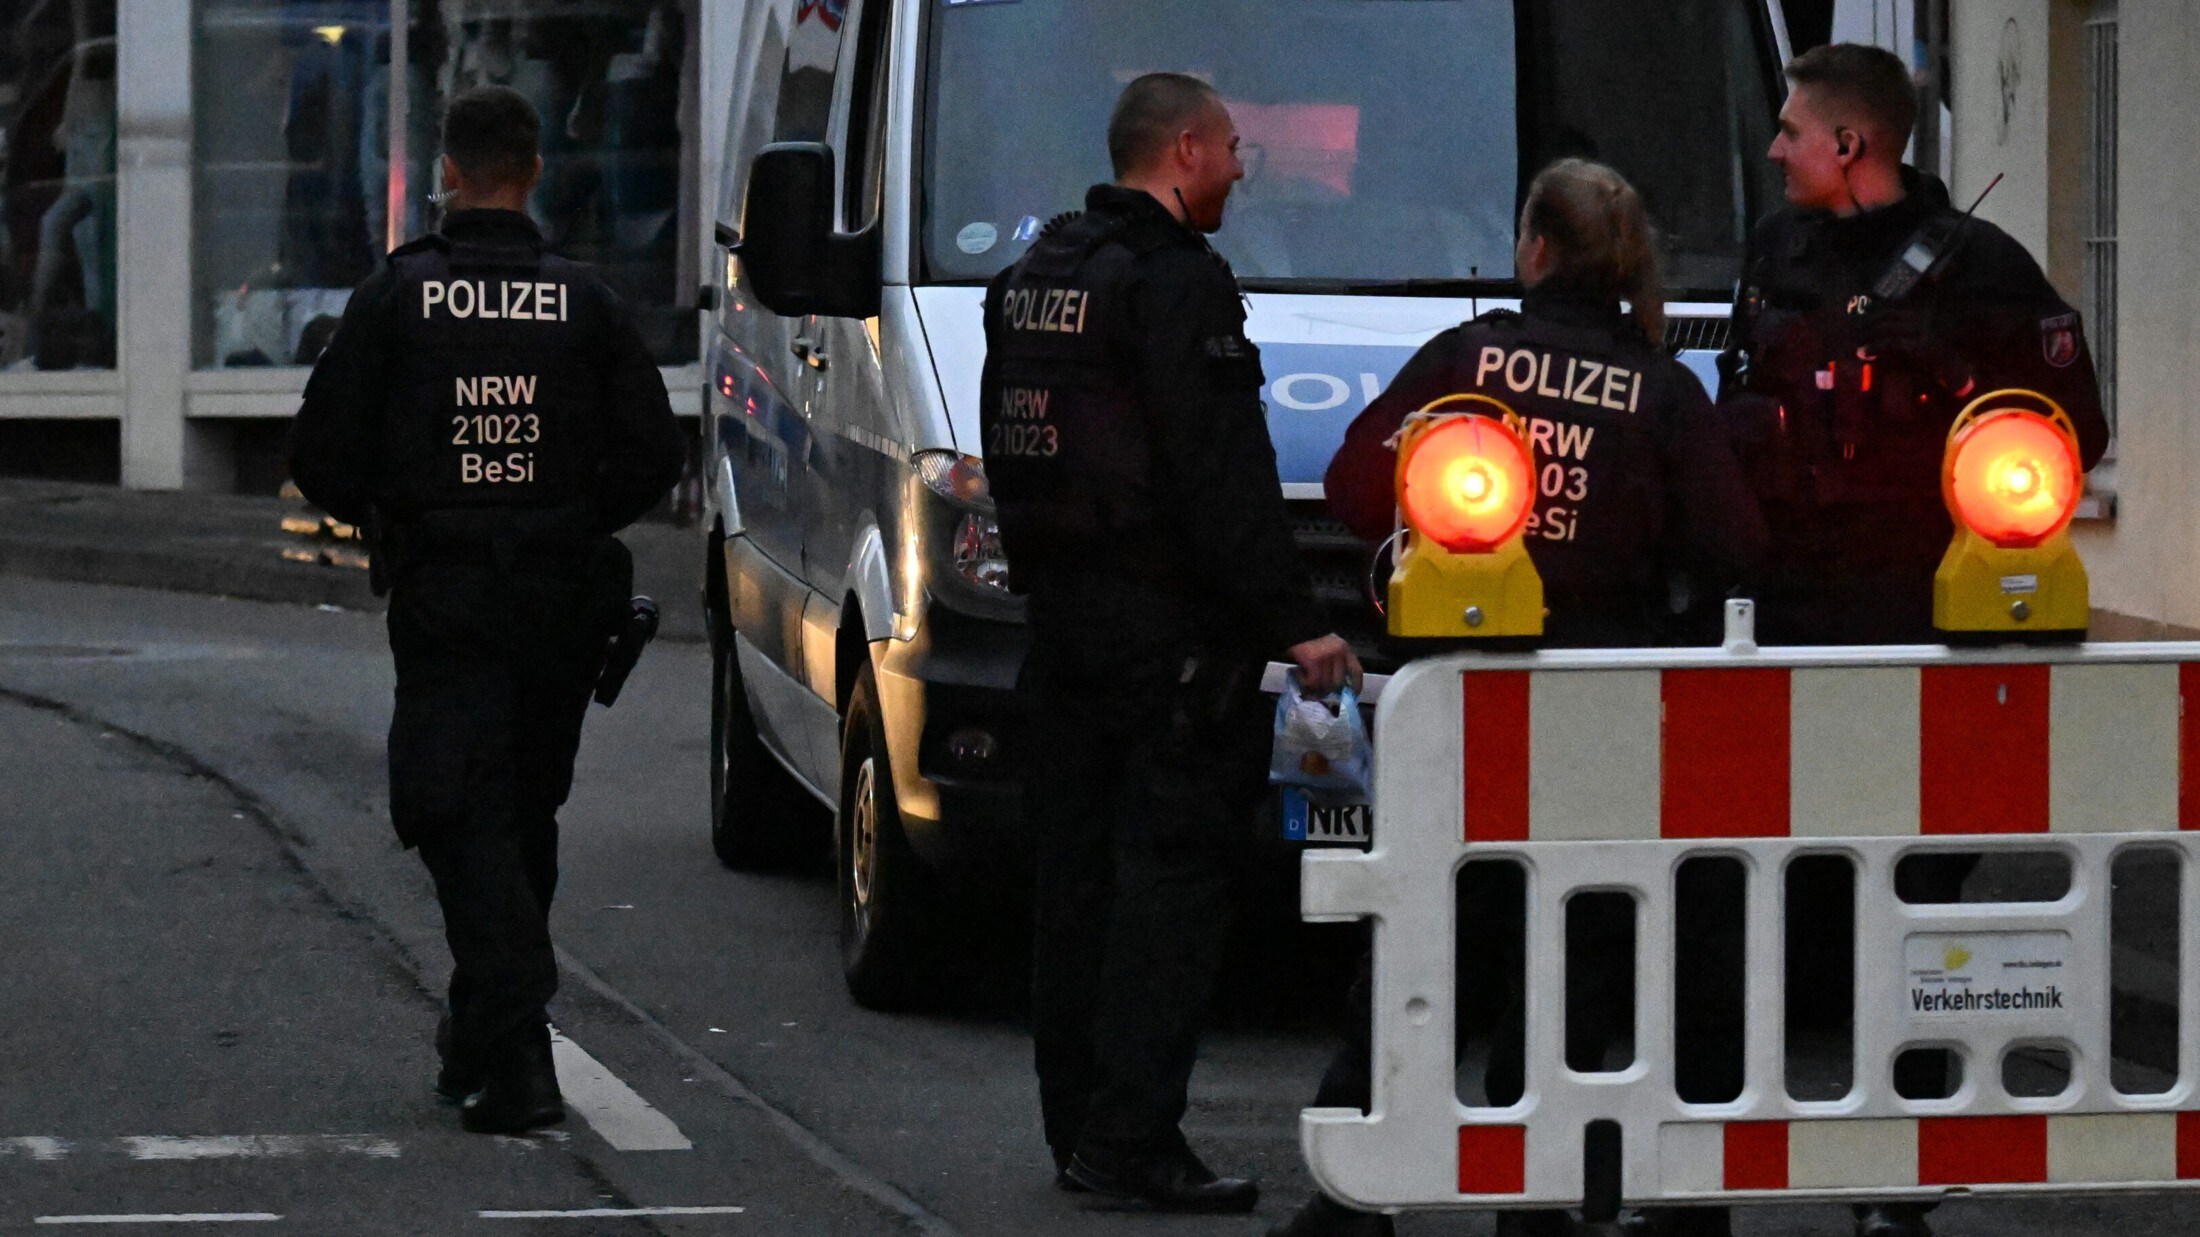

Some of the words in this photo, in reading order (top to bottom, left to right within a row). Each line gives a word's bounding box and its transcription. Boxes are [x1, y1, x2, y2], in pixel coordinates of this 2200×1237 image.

[422, 280, 568, 322] POLIZEI
[1003, 288, 1089, 334] POLIZEI
[455, 375, 537, 406] NRW
[1476, 346, 1642, 413] POLIZEI
[1001, 386, 1049, 420] NRW
[451, 413, 540, 446] 21023
[990, 423, 1059, 457] 21023
[461, 452, 534, 484] BeSi
[1525, 508, 1578, 542] eSi
[1289, 819, 1299, 831] D
[1911, 986, 2063, 1011] Verkehrstechnik
